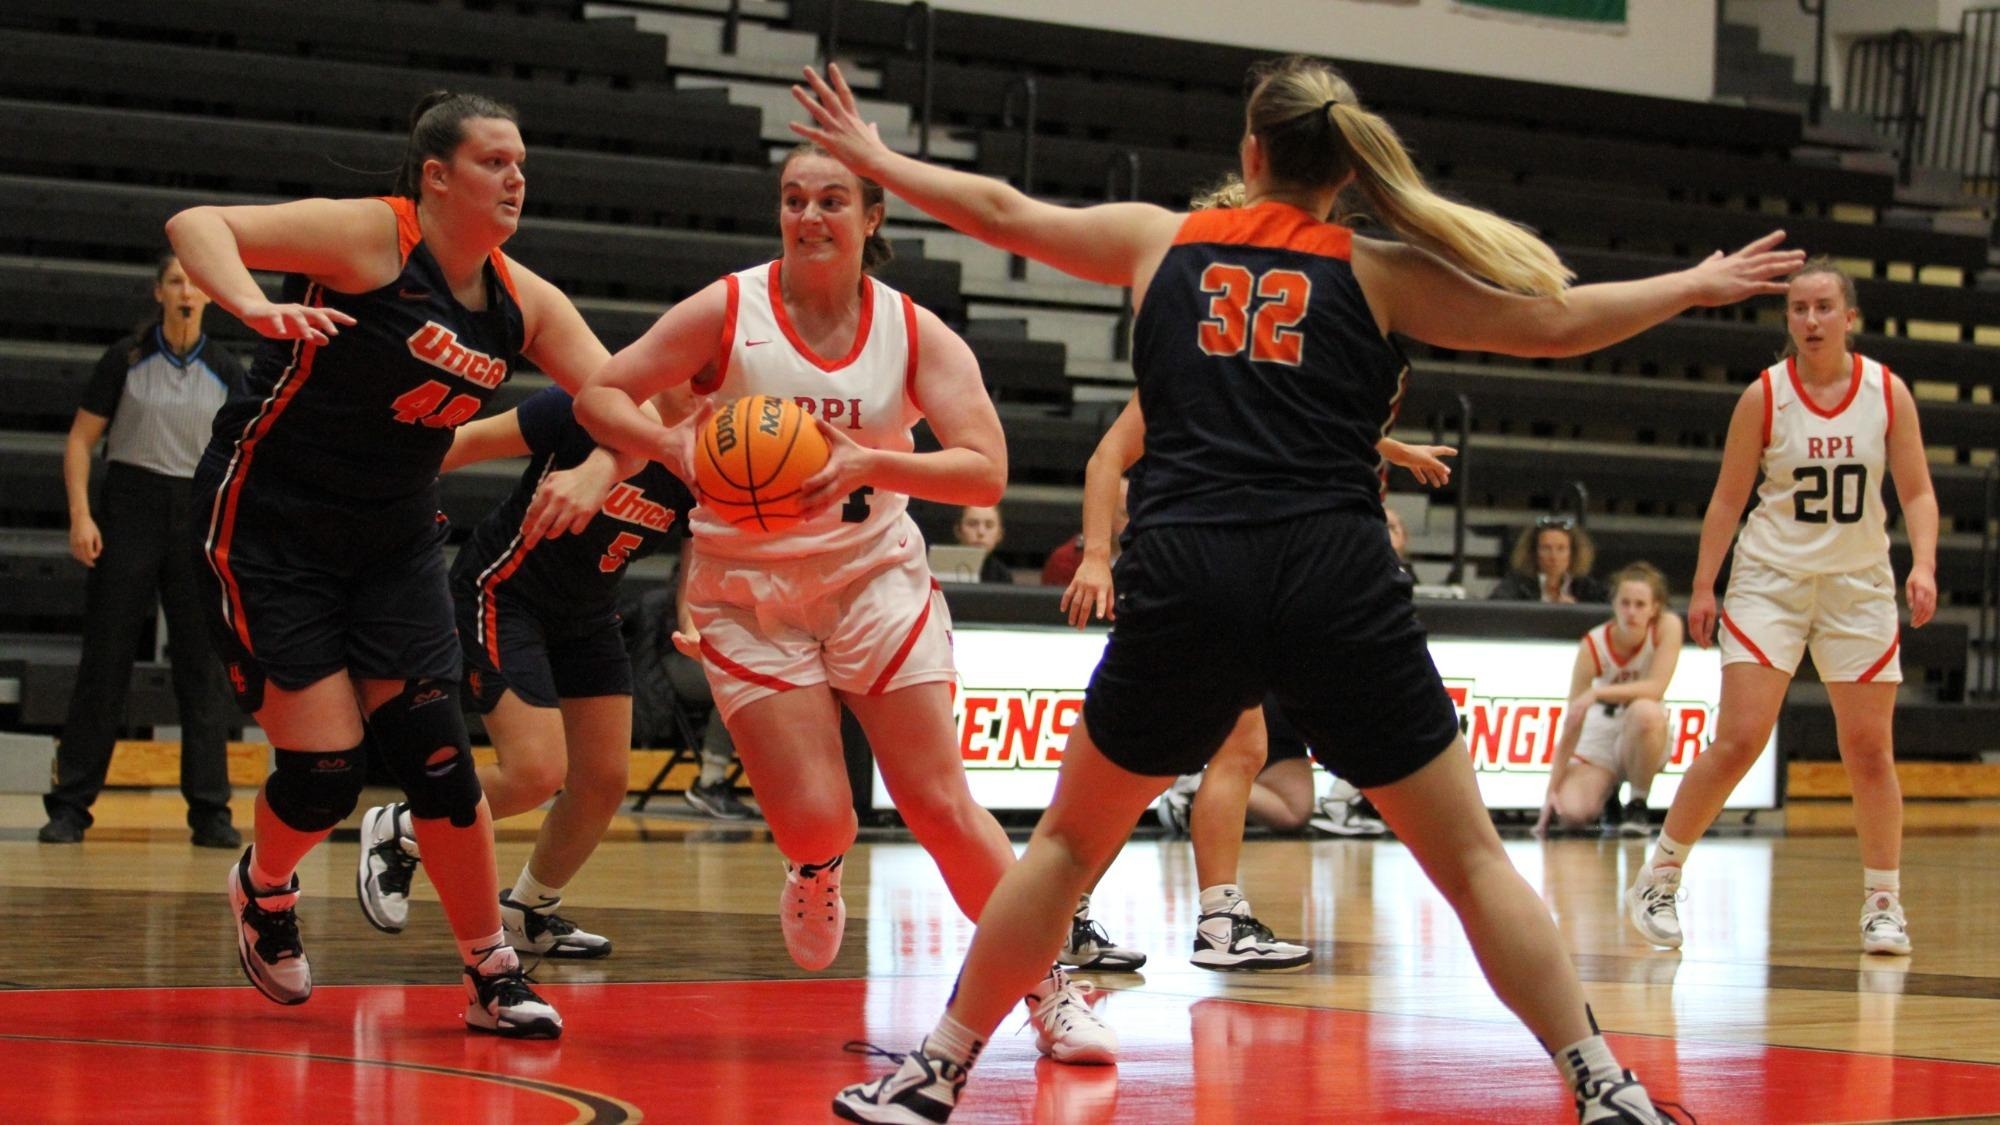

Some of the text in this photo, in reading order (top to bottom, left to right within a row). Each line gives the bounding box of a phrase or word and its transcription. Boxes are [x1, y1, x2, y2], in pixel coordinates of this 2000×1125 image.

[1198, 261, 1312, 367] 32
[407, 320, 508, 389] UTICA
[760, 395, 783, 437] NCA
[1807, 435, 1855, 459] RPI
[1792, 464, 1867, 524] 20
[599, 531, 643, 573] 5
